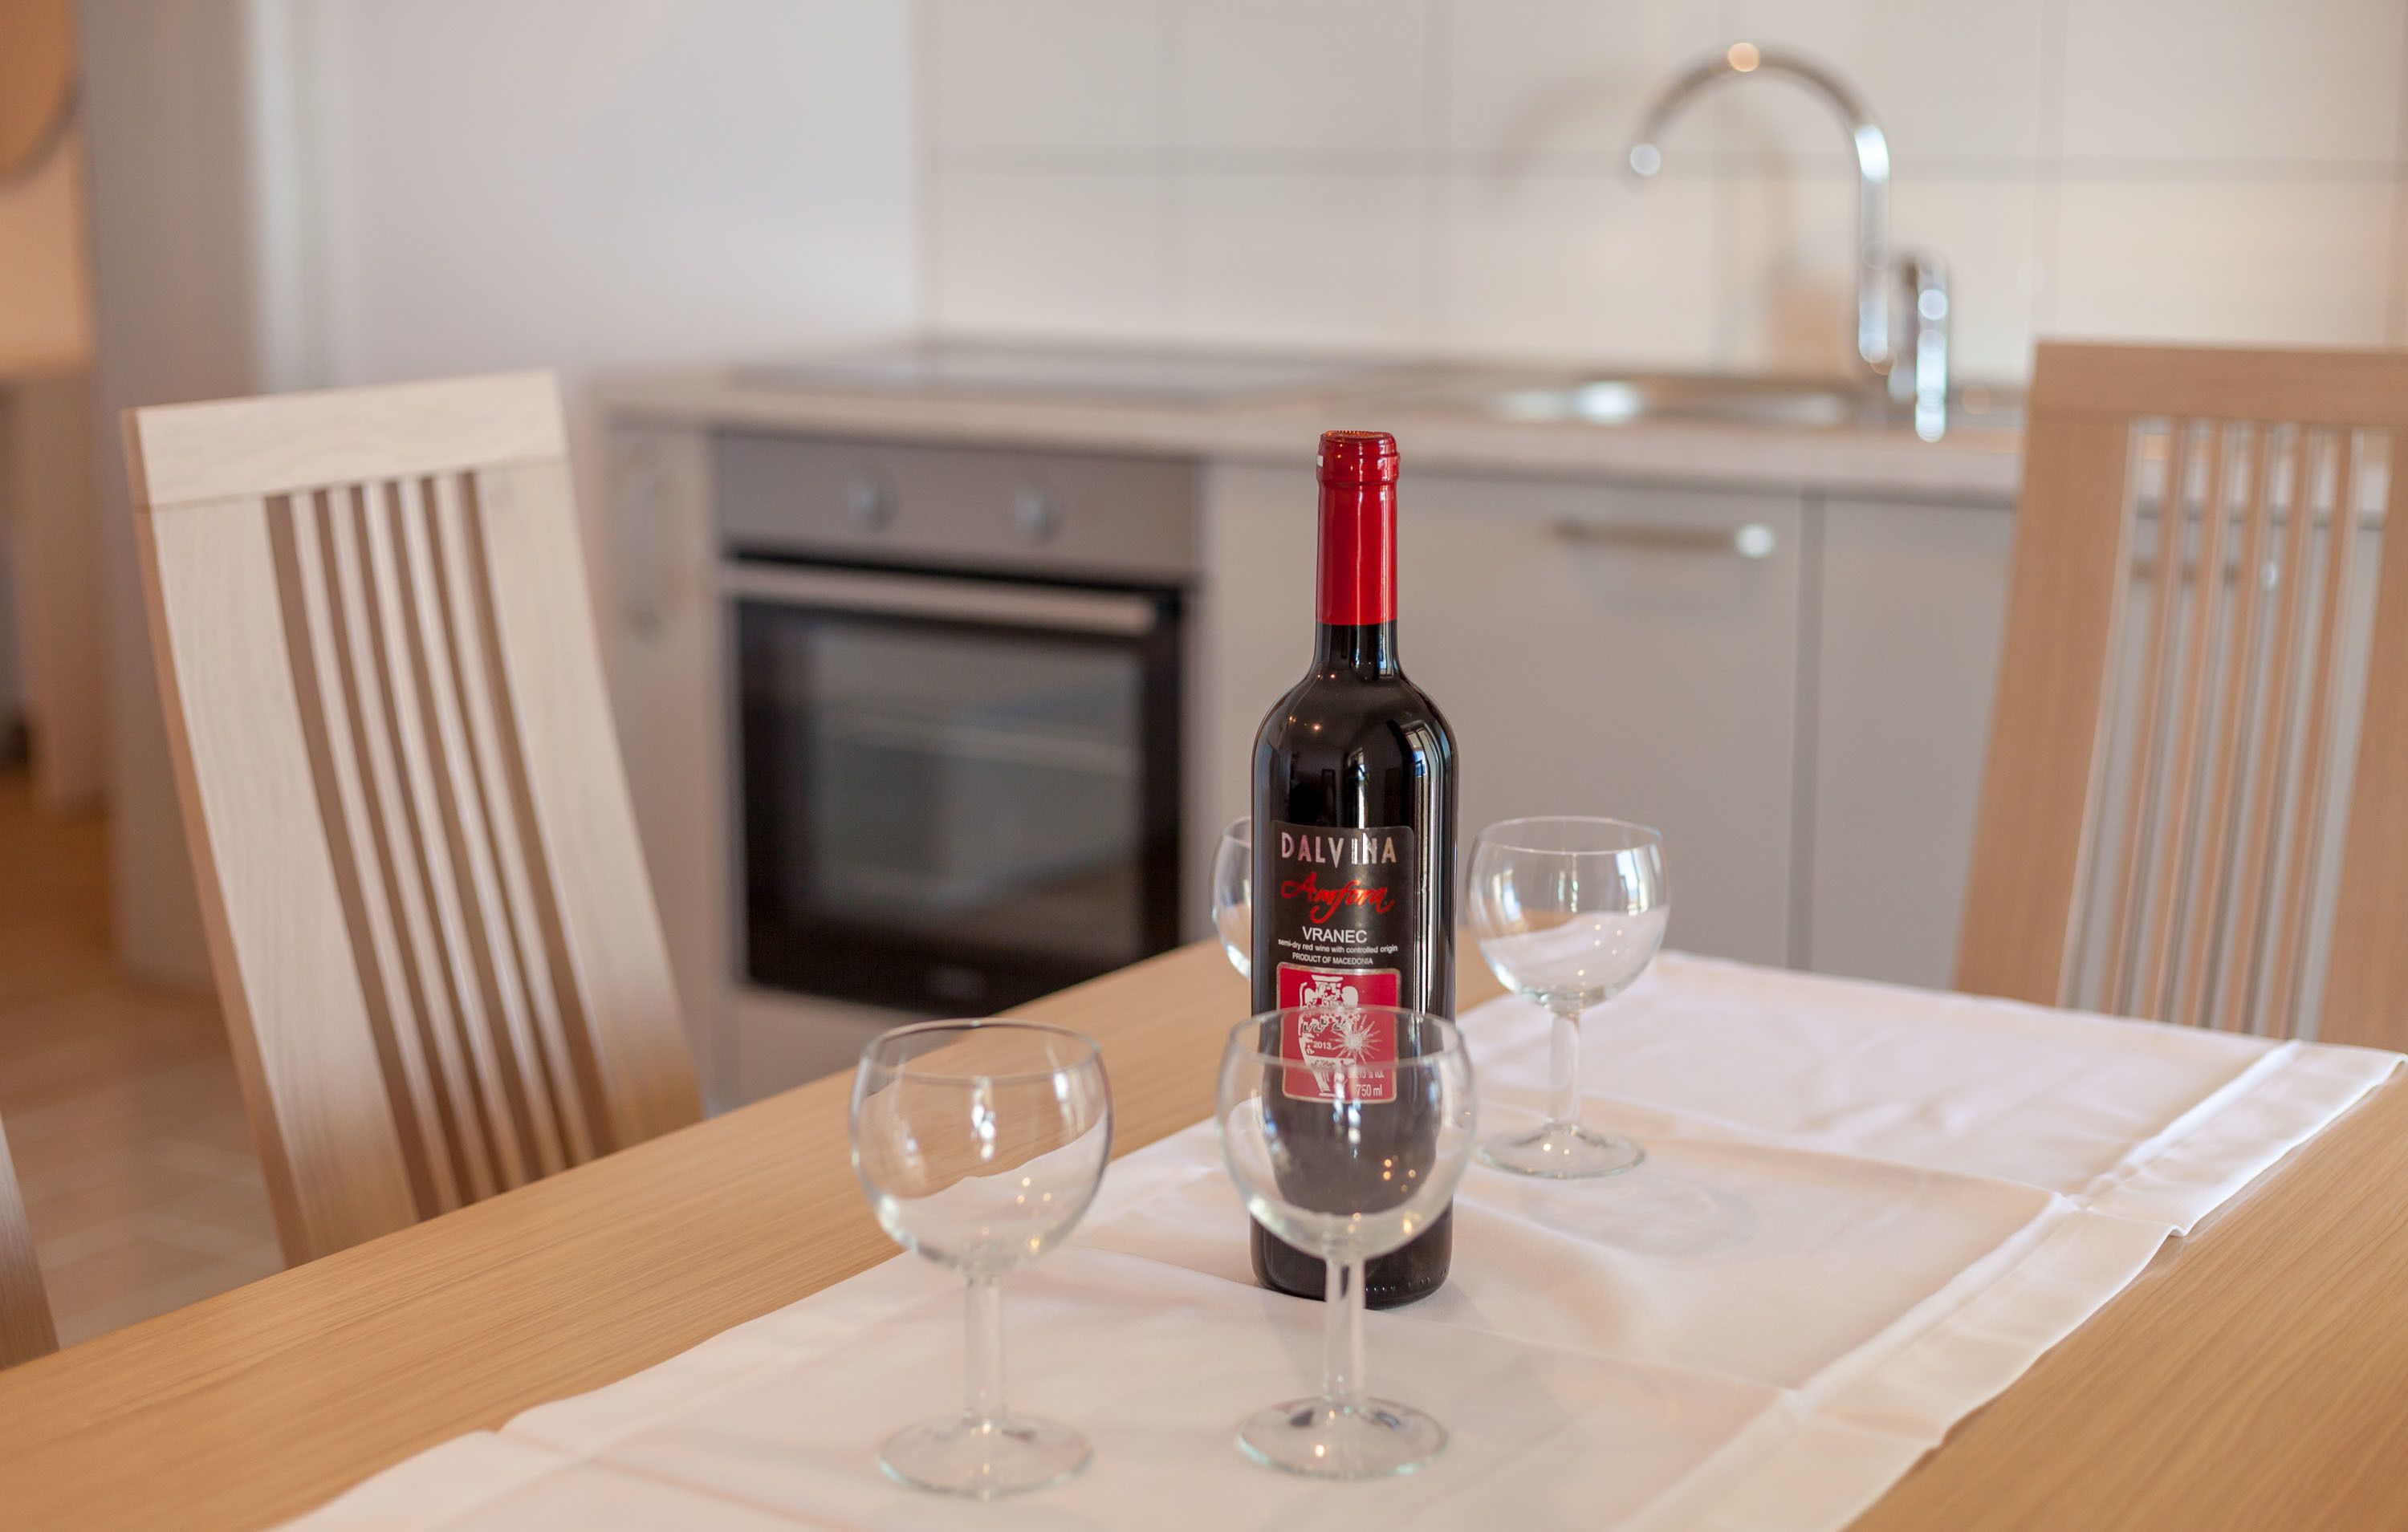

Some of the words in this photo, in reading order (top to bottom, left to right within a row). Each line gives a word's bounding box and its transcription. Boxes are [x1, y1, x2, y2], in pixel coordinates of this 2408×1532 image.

[1281, 831, 1397, 869] DALVINA
[1280, 872, 1395, 924] Amfora
[1303, 925, 1367, 944] VRANEC
[1278, 938, 1301, 950] semi-dry
[1315, 945, 1330, 953] wine
[1331, 945, 1344, 953] with
[1346, 945, 1378, 954] controlled
[1380, 945, 1398, 954] origin
[1292, 952, 1321, 963] PRODUCT
[1322, 956, 1332, 964] OF
[1332, 957, 1373, 965] MACEDONIA
[1313, 1041, 1332, 1050] 2013
[1357, 1083, 1372, 1097] 750
[1373, 1083, 1382, 1096] ml
